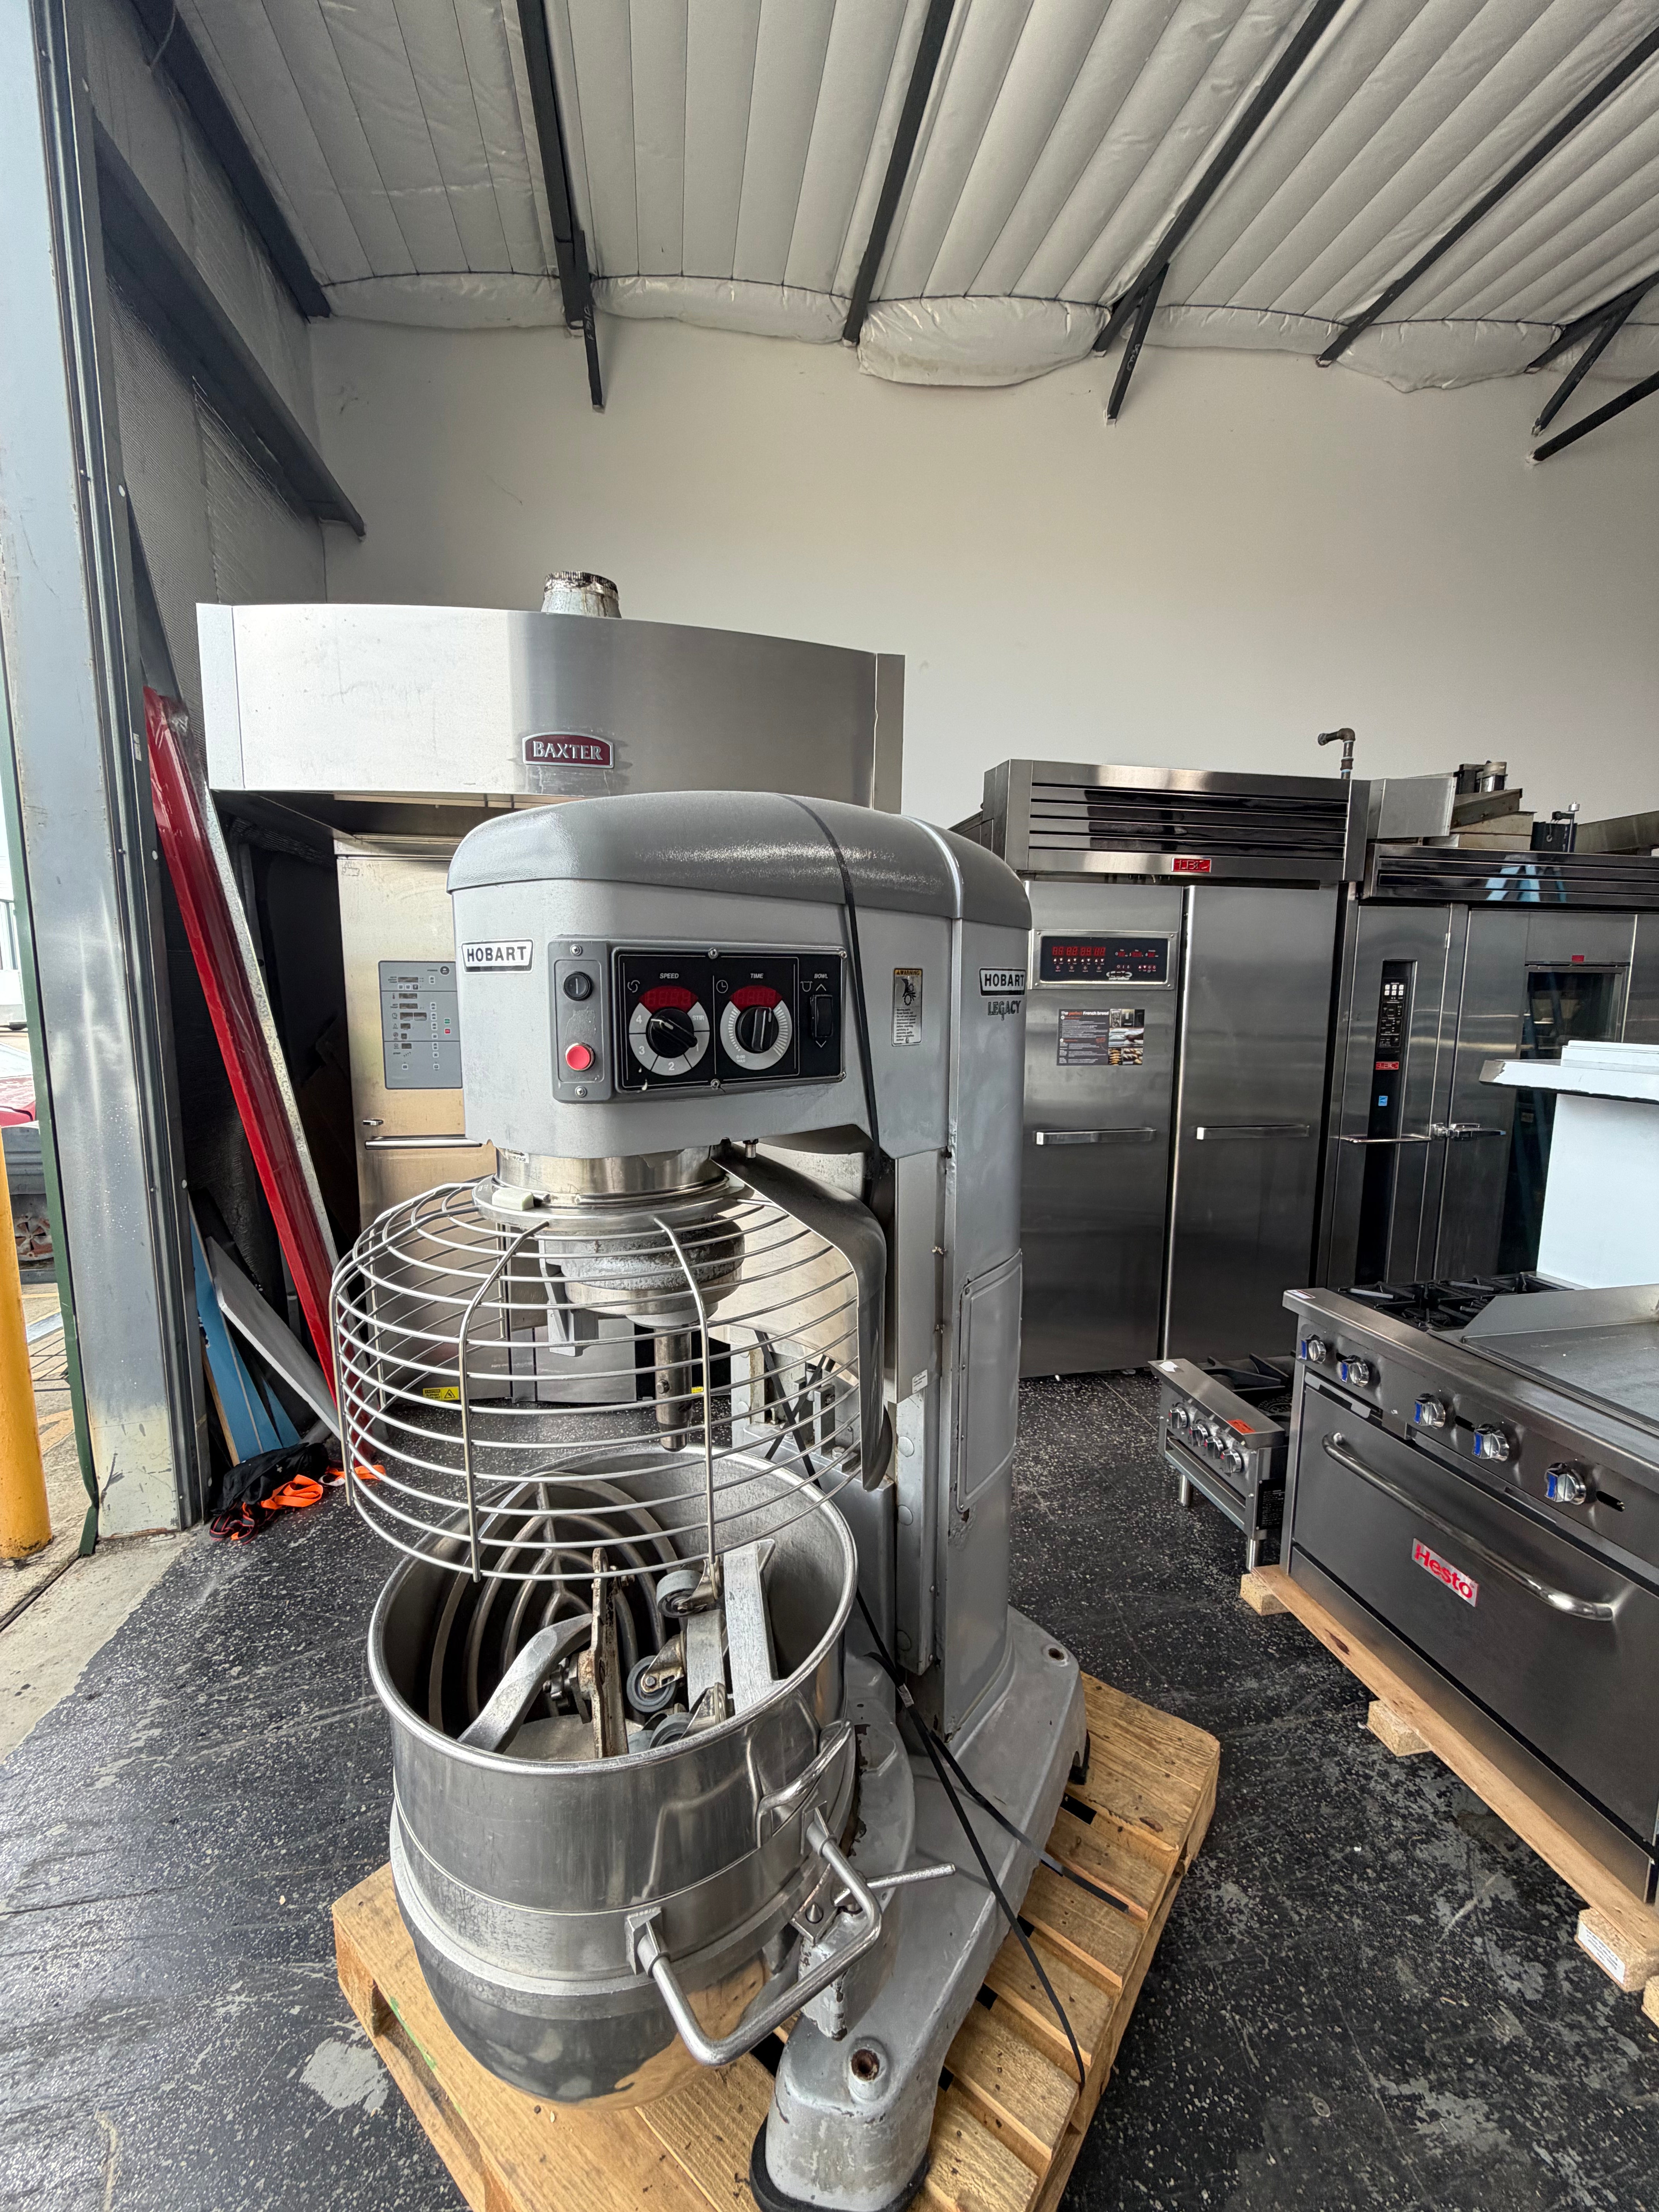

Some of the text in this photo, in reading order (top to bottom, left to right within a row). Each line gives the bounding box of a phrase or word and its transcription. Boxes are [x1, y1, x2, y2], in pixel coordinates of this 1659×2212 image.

[533, 740, 603, 761] BAXTER
[467, 946, 527, 962] HOBART
[984, 974, 1024, 987] HOBART
[988, 1001, 1021, 1021] LEGACY
[635, 1015, 642, 1024] 4
[639, 1046, 645, 1055] 3
[668, 1062, 675, 1071] 2
[1414, 1544, 1473, 1599] Hesto
